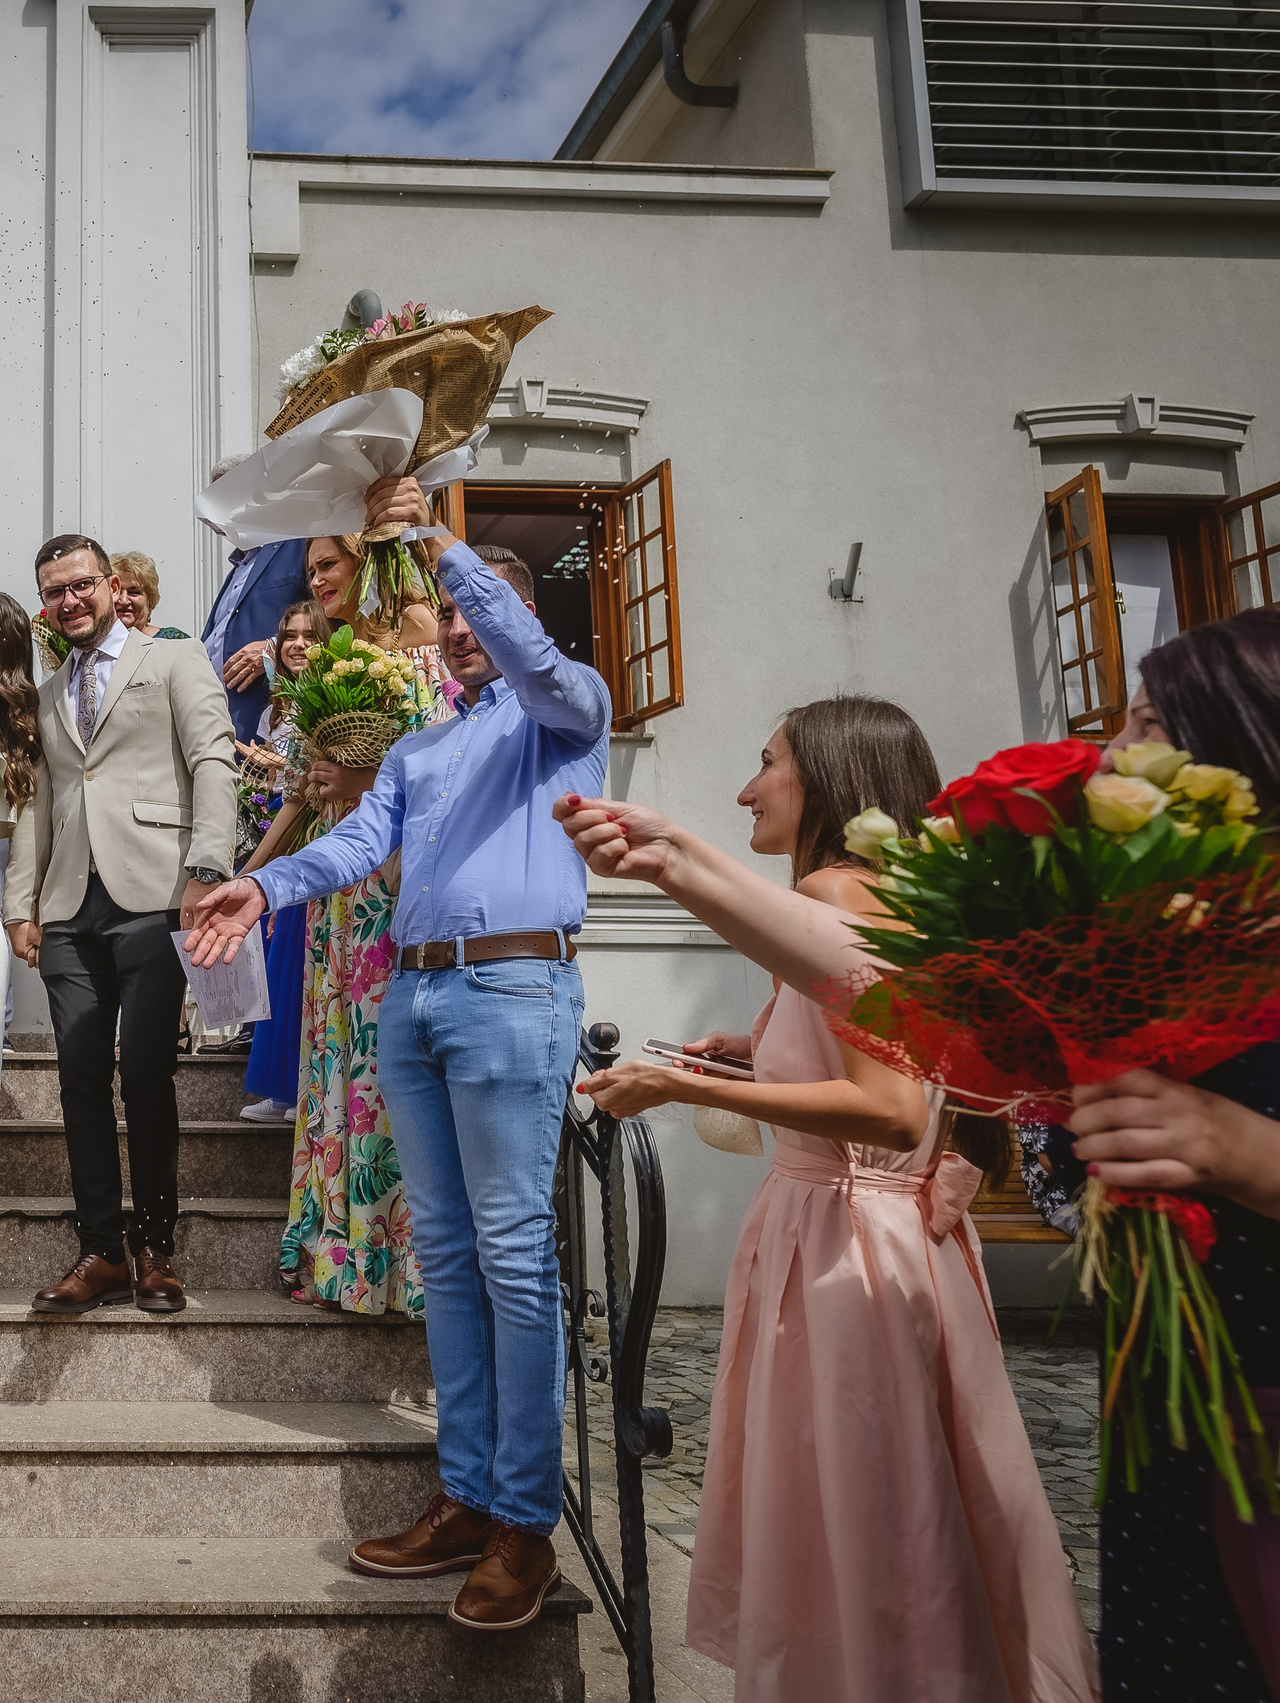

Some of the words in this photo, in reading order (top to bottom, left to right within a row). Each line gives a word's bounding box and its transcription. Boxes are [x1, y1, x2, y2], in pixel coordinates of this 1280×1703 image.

[296, 368, 325, 398] services
[319, 375, 332, 387] for
[289, 397, 297, 407] at
[295, 386, 320, 415] mental
[314, 381, 338, 407] Ofsted
[266, 407, 290, 434] schools
[275, 413, 297, 436] health
[290, 406, 315, 429] inspe
